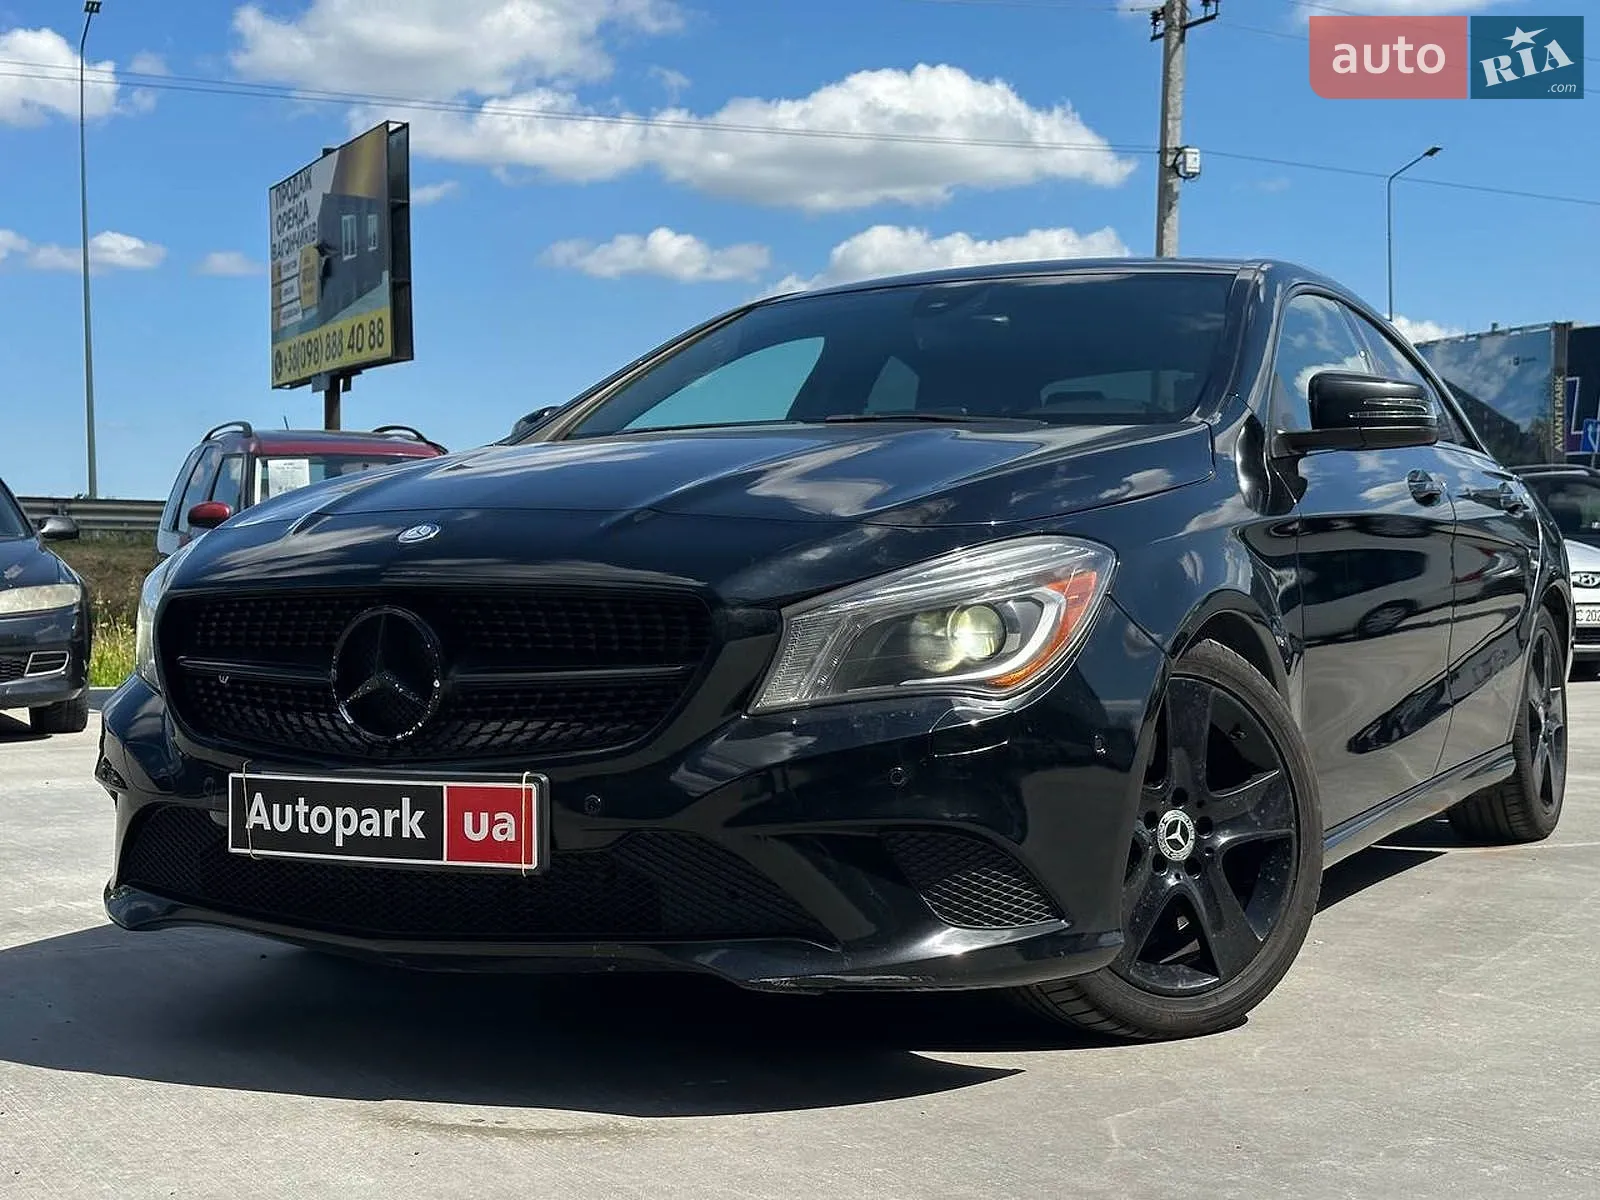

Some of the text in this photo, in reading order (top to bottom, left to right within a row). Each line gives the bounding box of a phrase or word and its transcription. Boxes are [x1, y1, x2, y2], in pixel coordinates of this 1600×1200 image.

[275, 167, 313, 210] ПРОДАЖ
[276, 197, 310, 236] ОРЕНДА
[283, 317, 385, 377] +38(098) 888 40 88
[1554, 375, 1564, 453] AVANT PARK
[246, 791, 516, 847] Autopark ua
